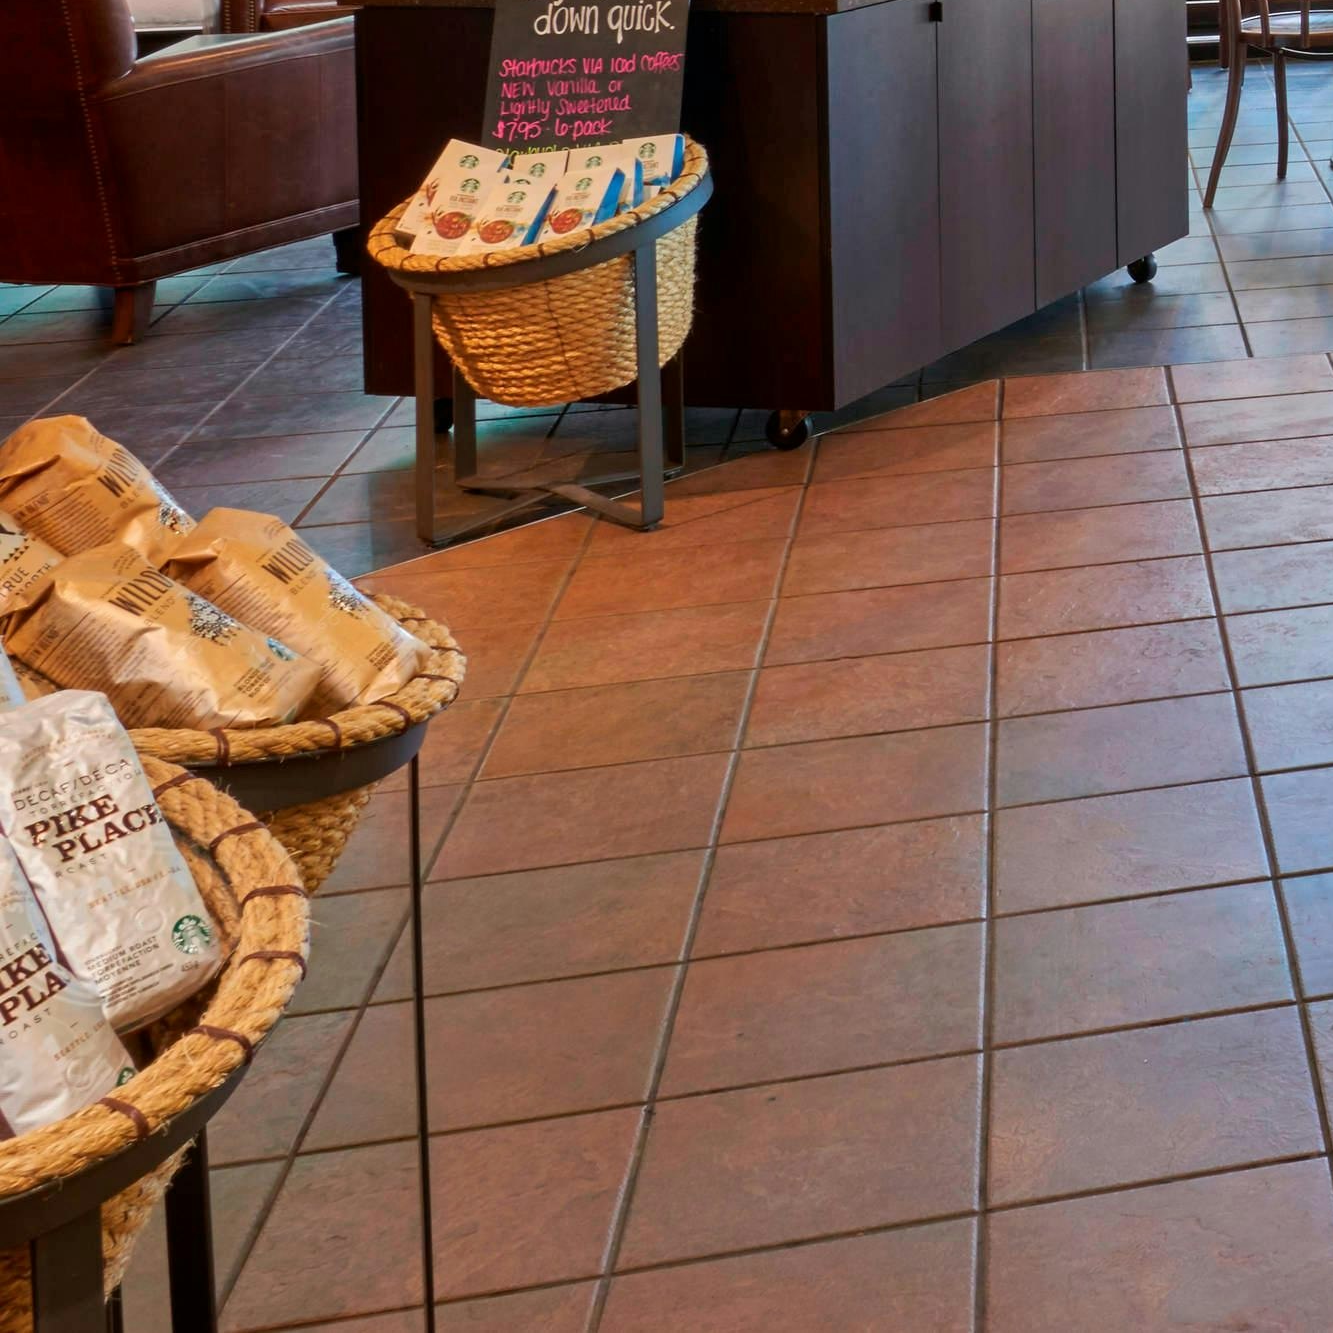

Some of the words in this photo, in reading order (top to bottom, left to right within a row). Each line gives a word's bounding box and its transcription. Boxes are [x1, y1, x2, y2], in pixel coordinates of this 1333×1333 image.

[533, 0, 599, 35] down
[607, 0, 676, 44] quick.
[501, 81, 536, 98] NEW
[608, 79, 624, 93] or
[583, 57, 603, 74] VIA
[97, 448, 141, 498] WILLO
[261, 538, 315, 585] WILLO
[108, 565, 174, 617] WILLO
[24, 794, 119, 847] PIKE
[55, 853, 107, 878] ROAST
[129, 935, 158, 952] ROAST
[0, 943, 53, 996] IKE
[0, 969, 69, 1027] PLA
